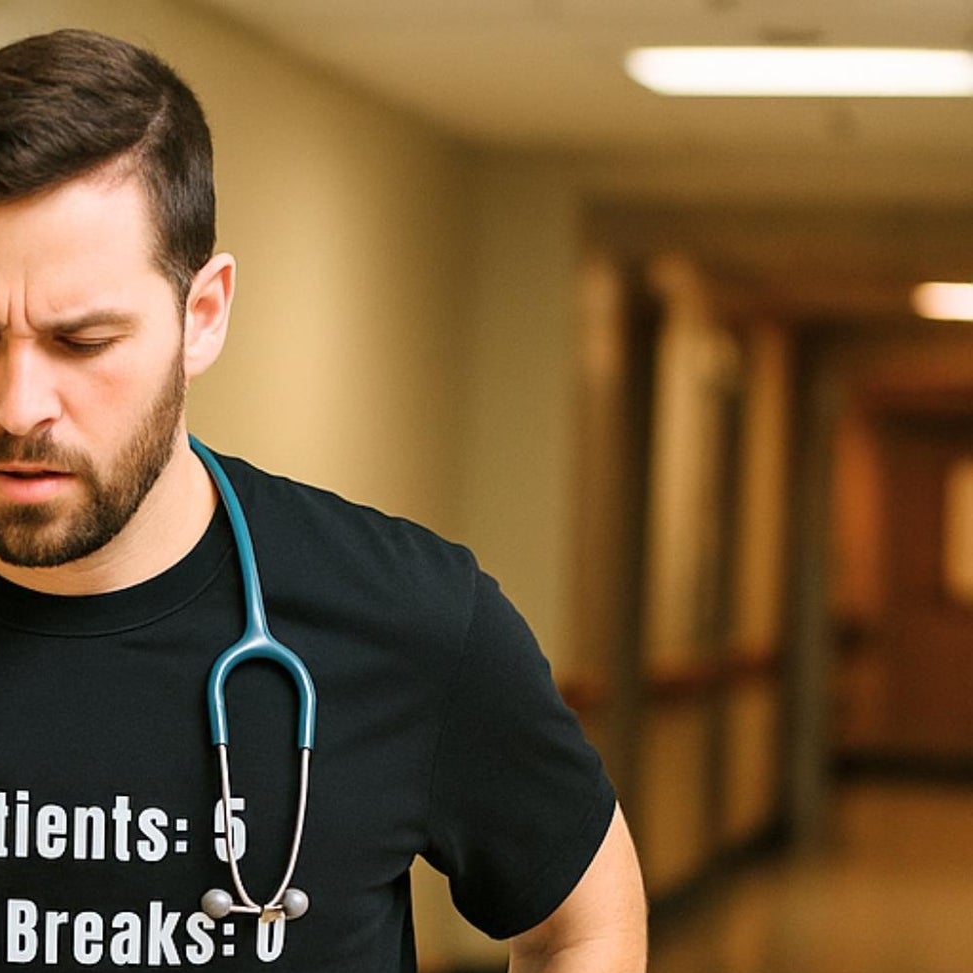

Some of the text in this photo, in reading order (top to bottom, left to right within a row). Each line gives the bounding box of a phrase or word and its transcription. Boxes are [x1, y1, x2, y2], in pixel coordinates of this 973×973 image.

[214, 798, 247, 862] 5
[7, 898, 235, 966] Breaks:
[256, 908, 287, 963] 0
